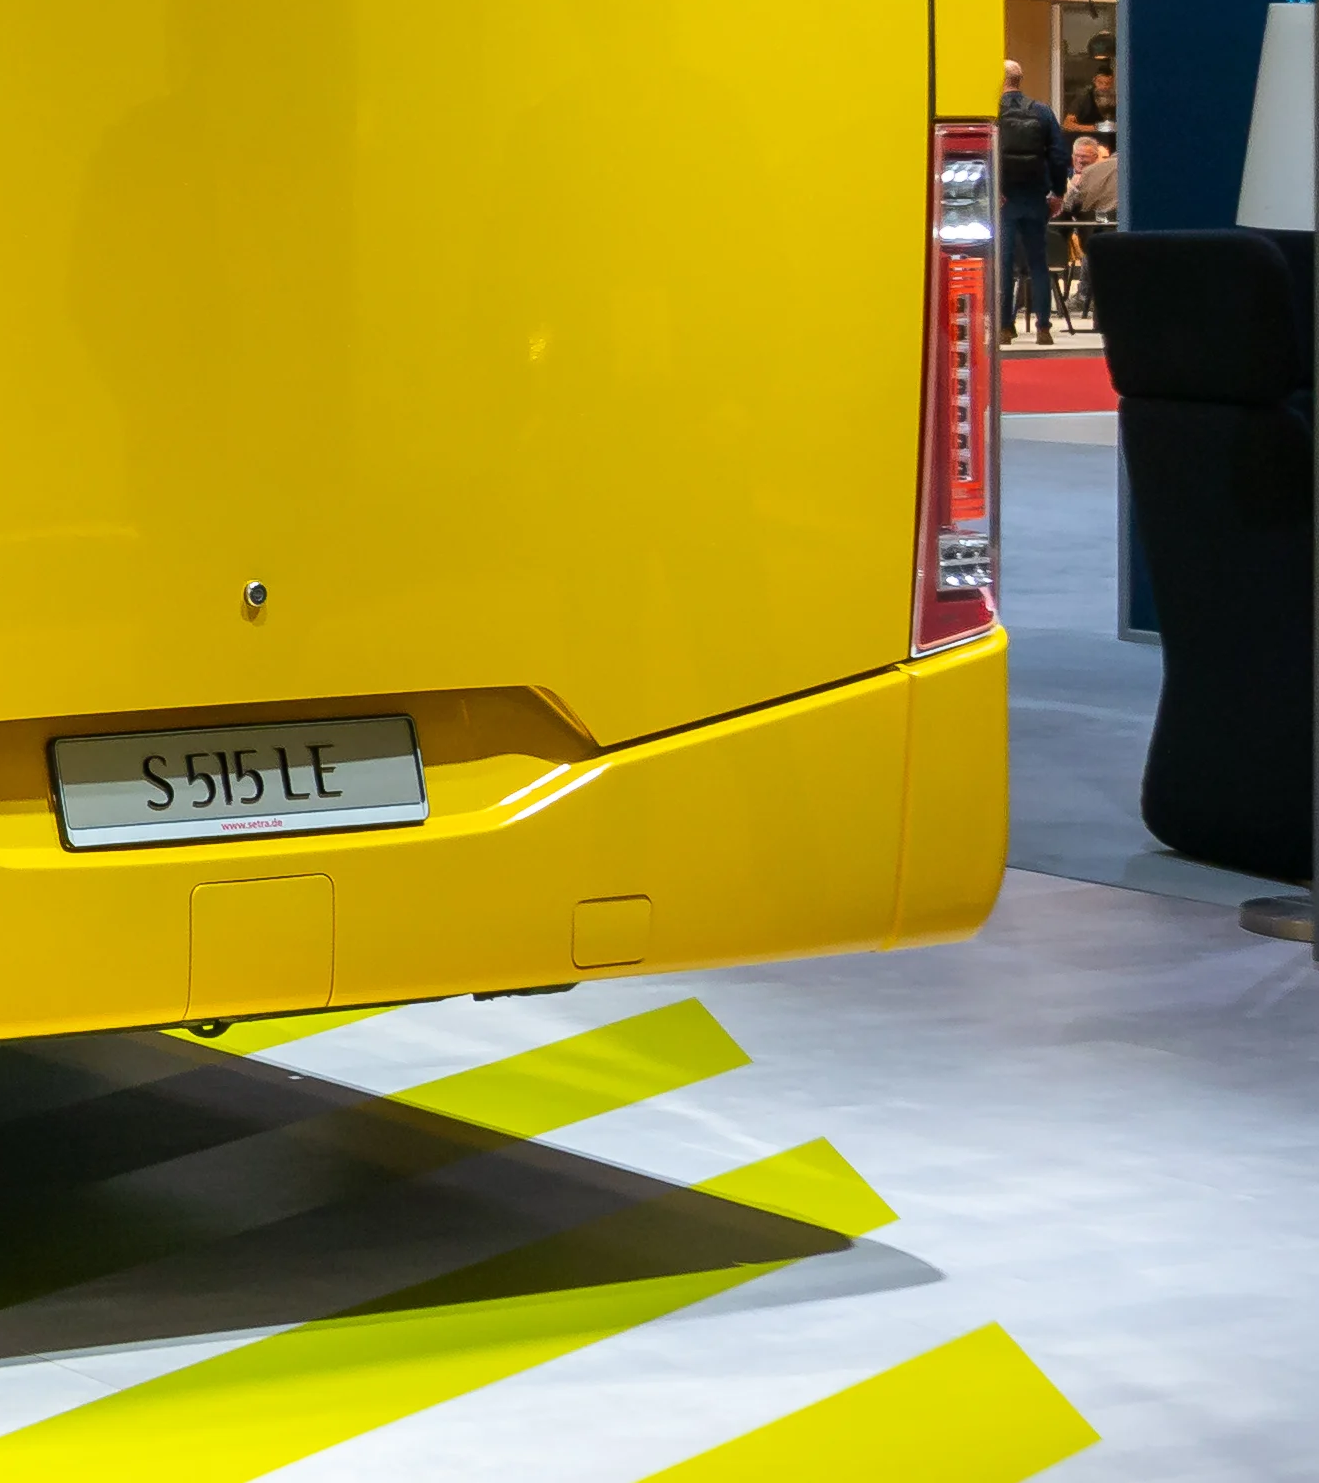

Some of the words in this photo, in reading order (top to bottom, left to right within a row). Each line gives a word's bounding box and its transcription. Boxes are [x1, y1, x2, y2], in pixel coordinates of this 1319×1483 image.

[142, 754, 175, 811] S
[185, 748, 264, 809] 515
[274, 743, 343, 801] LE
[221, 818, 283, 830] www.setra.de
